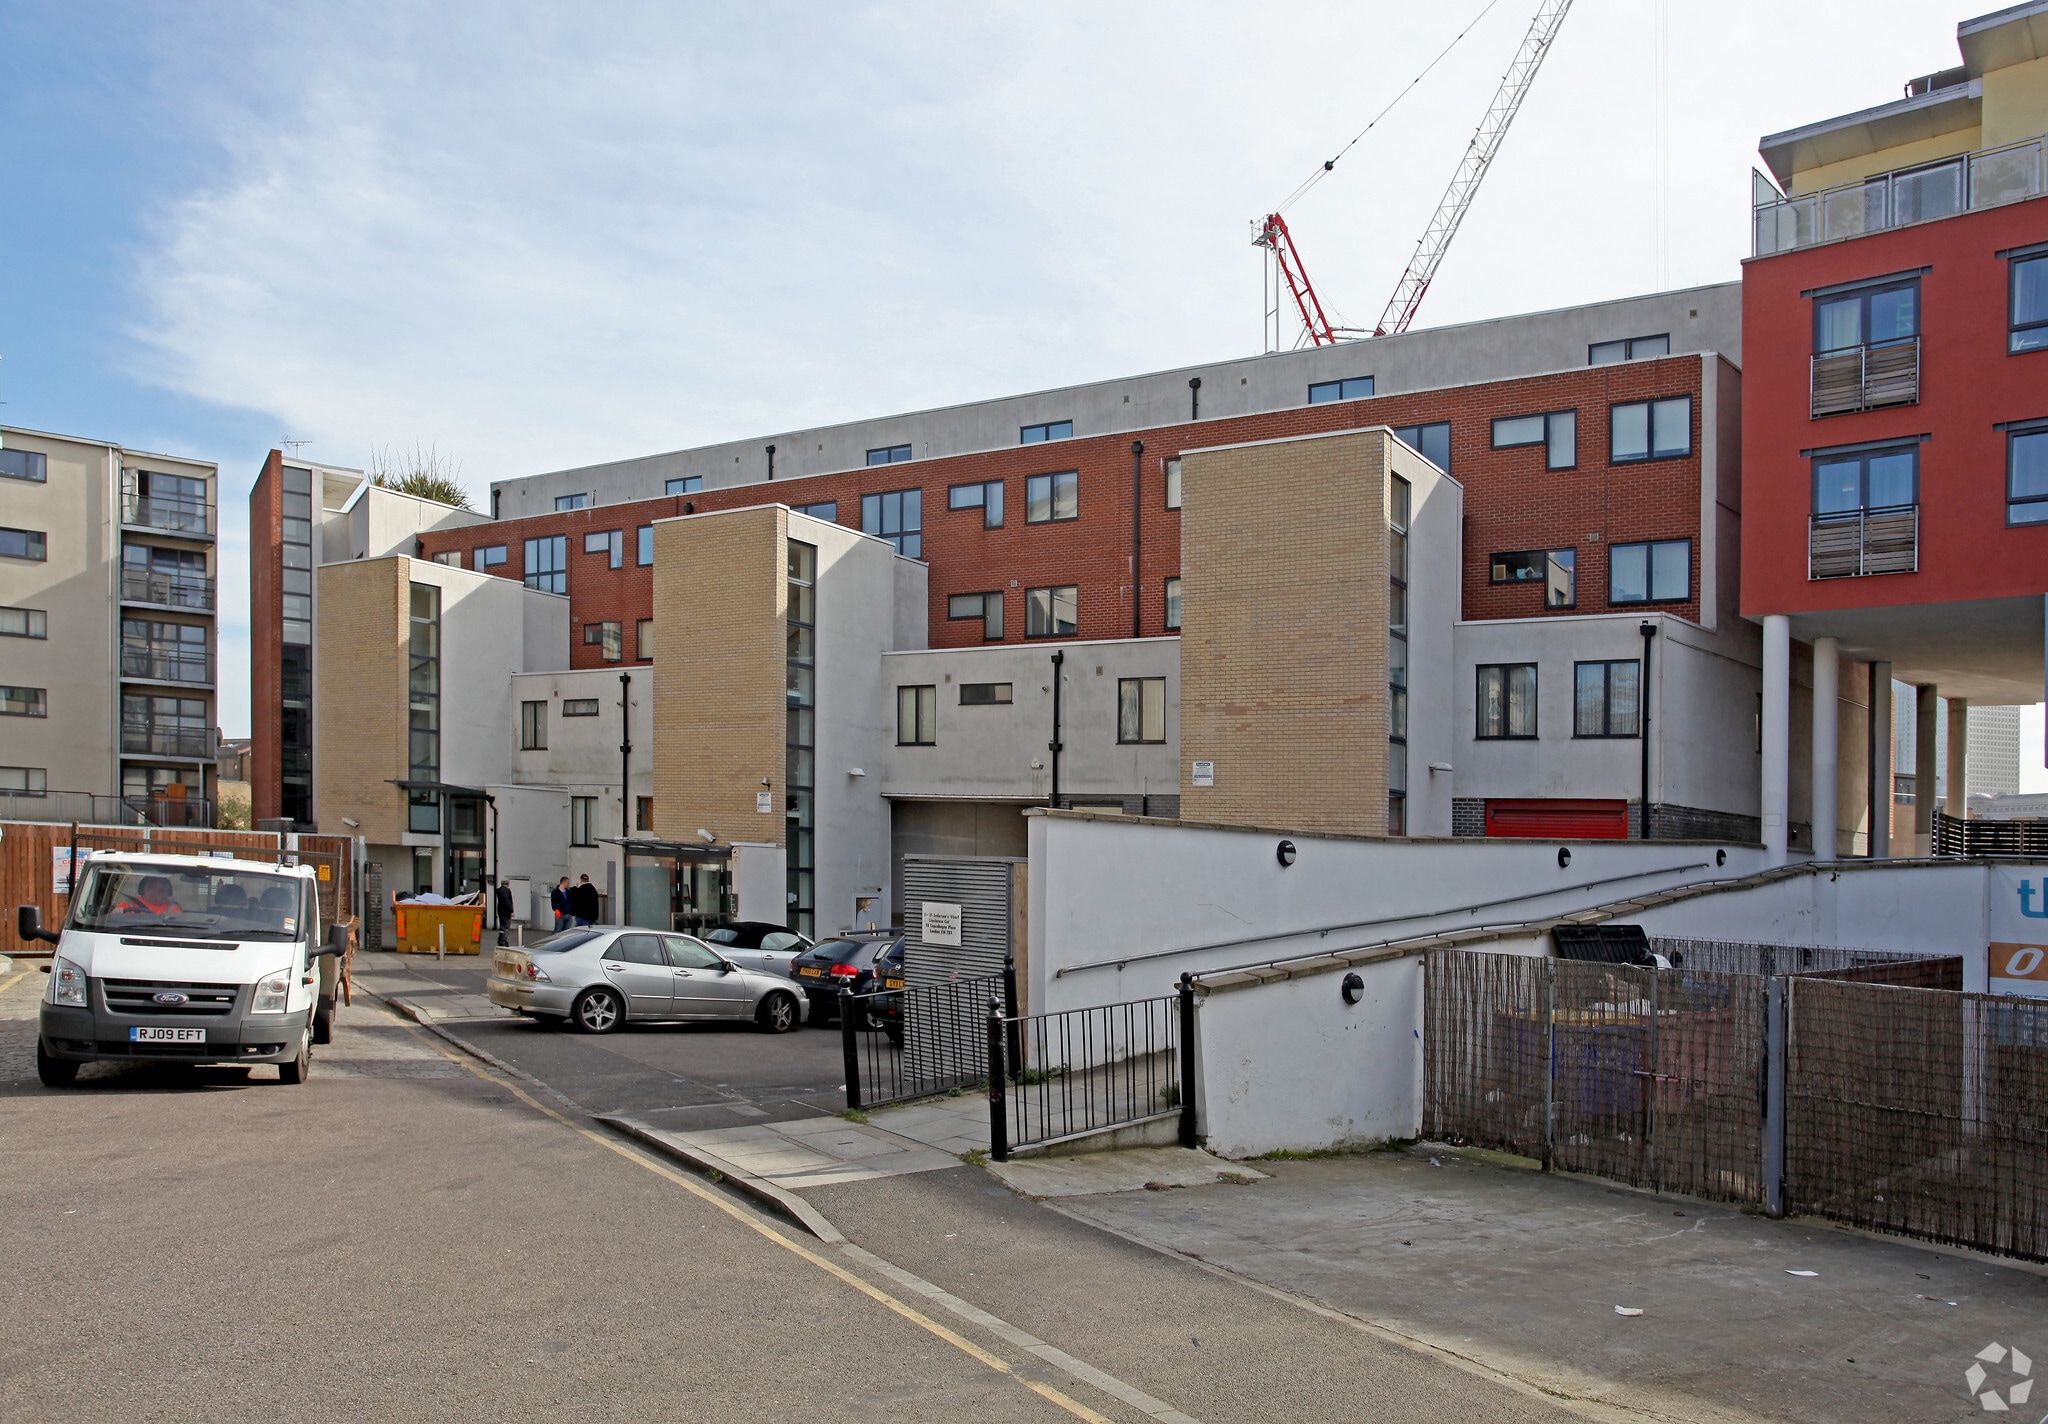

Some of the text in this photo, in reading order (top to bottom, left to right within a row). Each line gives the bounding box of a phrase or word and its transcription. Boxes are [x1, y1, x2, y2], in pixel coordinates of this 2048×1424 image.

[2017, 877, 2048, 918] t
[139, 1029, 203, 1040] RJ09 EFT
